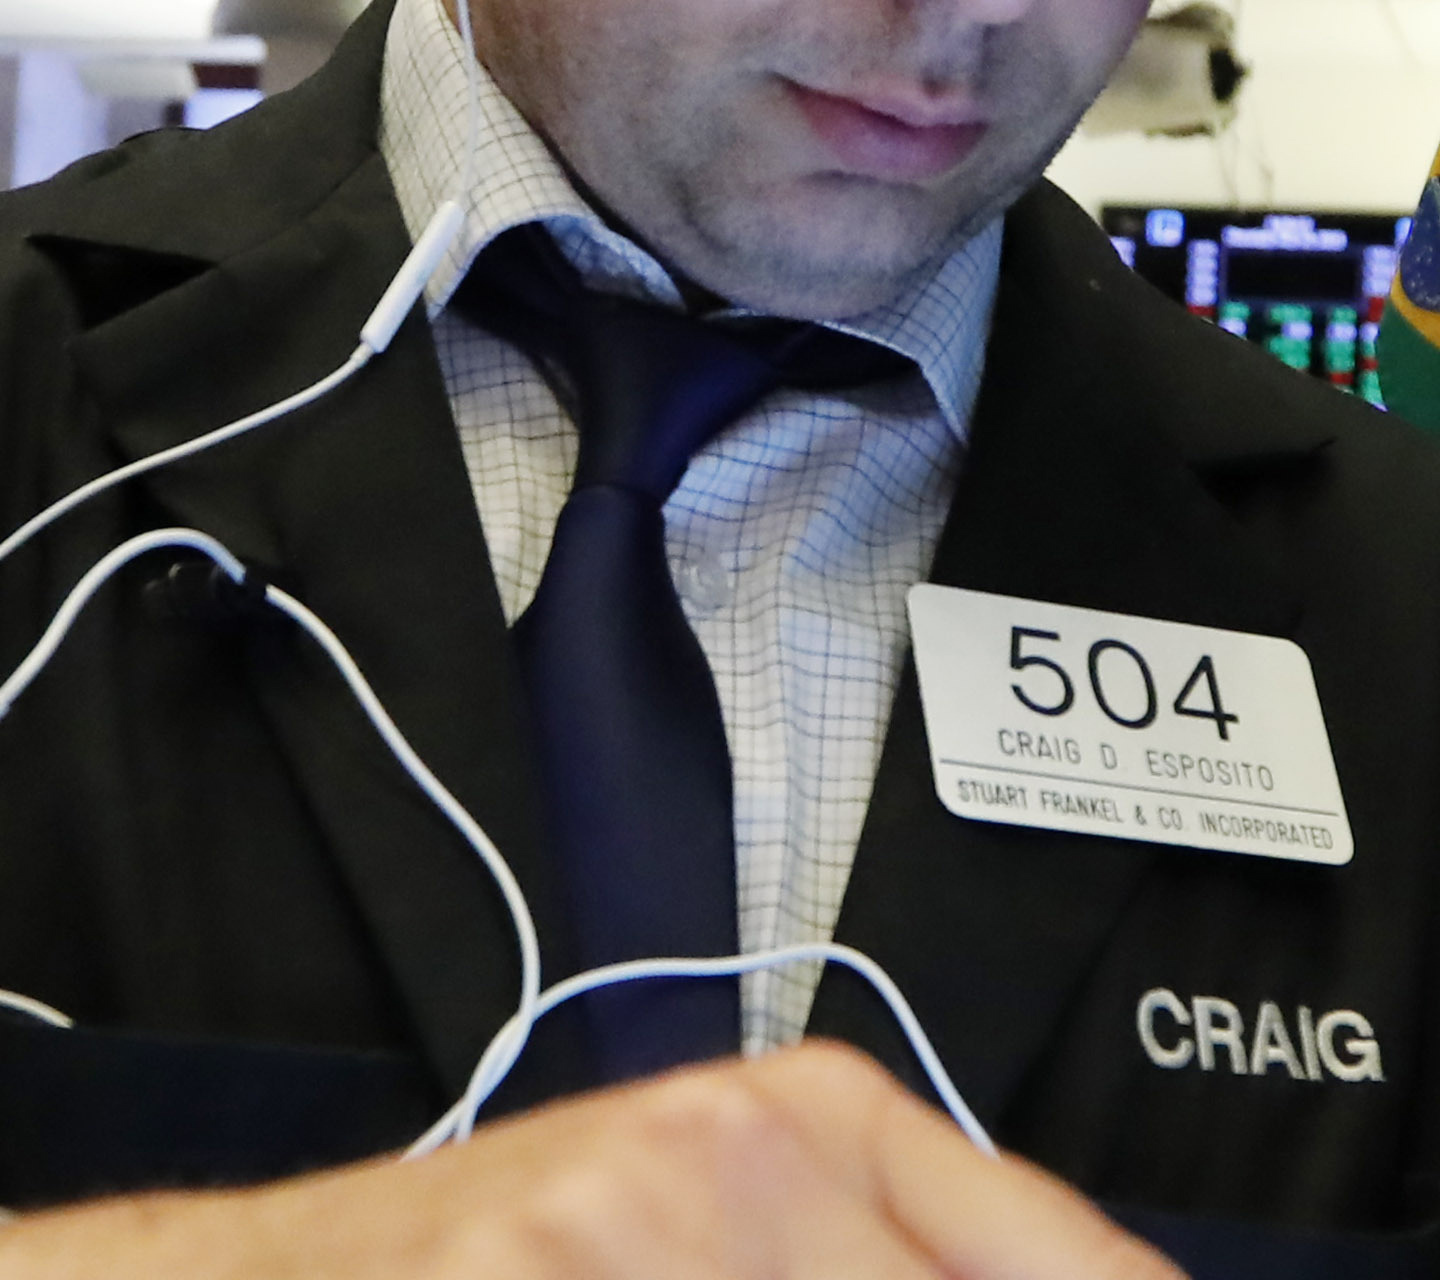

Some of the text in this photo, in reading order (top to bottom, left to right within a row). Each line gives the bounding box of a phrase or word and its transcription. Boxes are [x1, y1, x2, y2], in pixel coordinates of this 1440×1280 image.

[1009, 626, 1238, 741] 504
[998, 730, 1081, 766] CRAIG
[1146, 750, 1275, 791] ESPOSITO
[957, 780, 1029, 810] STUART
[1040, 791, 1123, 824] FRANKEL
[1134, 804, 1148, 826] &
[1199, 812, 1334, 851] INCORPORATED
[1136, 987, 1386, 1082] CRAIG
